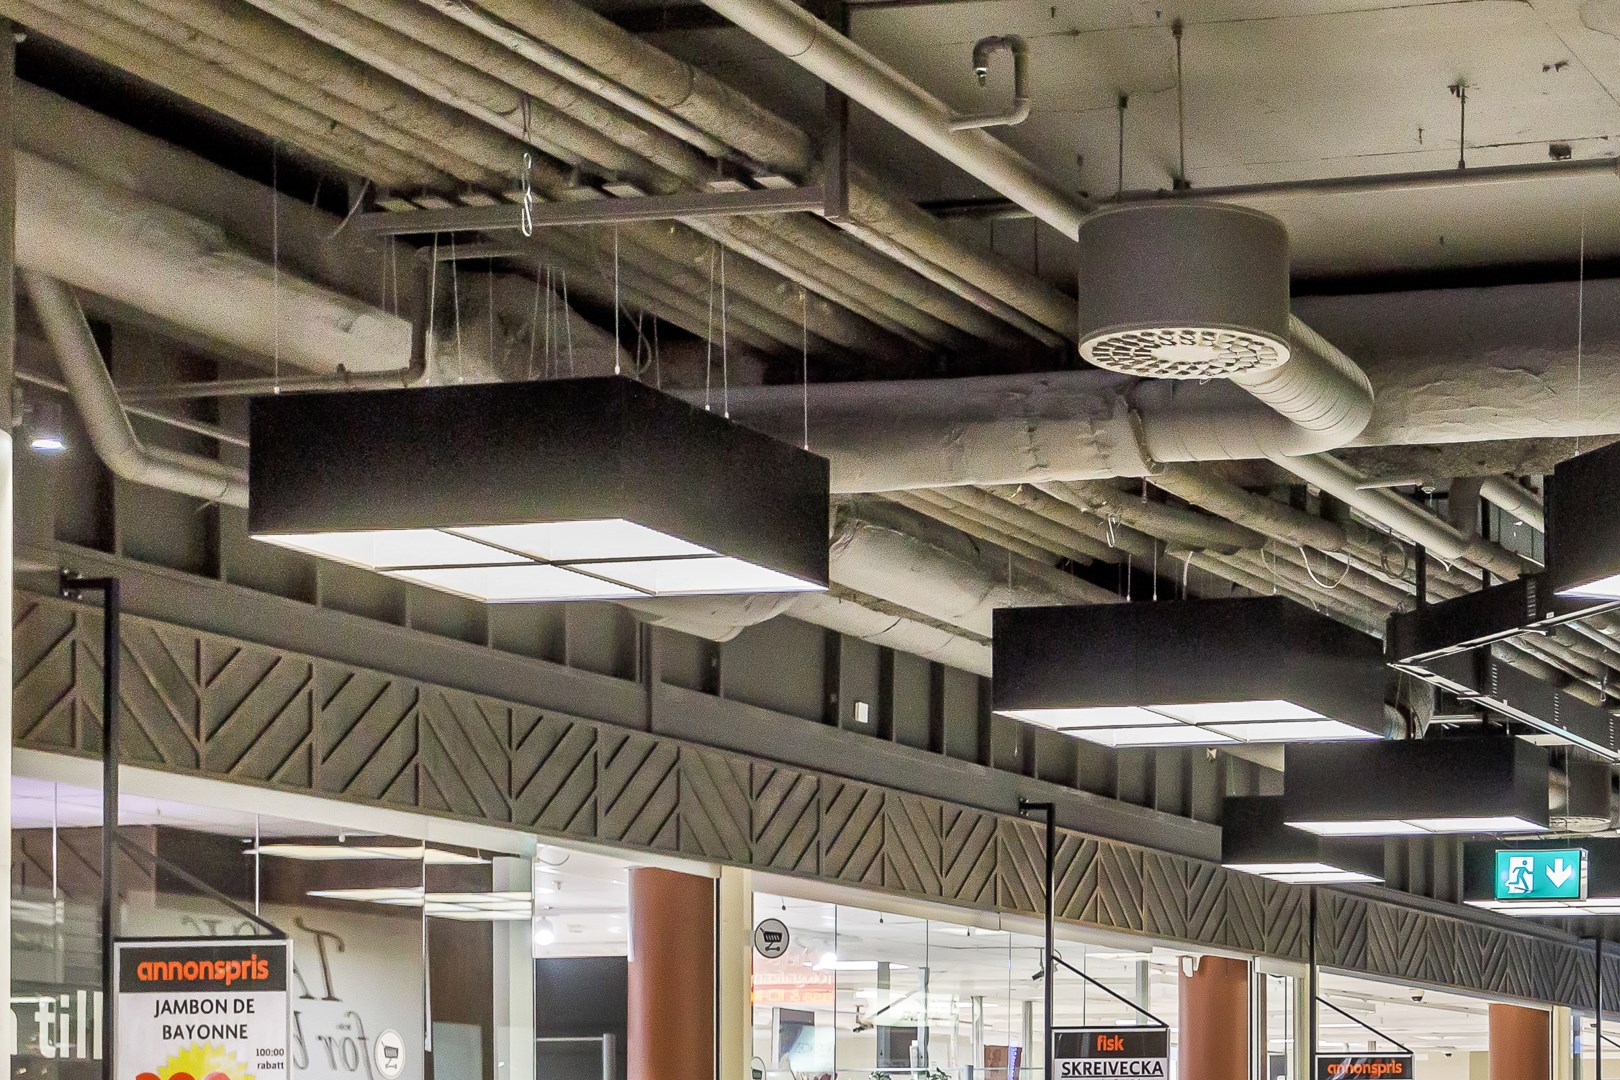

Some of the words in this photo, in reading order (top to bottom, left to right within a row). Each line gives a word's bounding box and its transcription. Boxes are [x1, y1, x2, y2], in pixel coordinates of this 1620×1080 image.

[137, 954, 269, 986] annonspris
[154, 999, 227, 1018] JAMBON
[233, 998, 256, 1014] DE
[34, 989, 103, 1060] till
[162, 1024, 248, 1040] BAYONNE
[1097, 1035, 1124, 1051] fisk
[256, 1048, 285, 1057] 100:00
[257, 1061, 285, 1070] rabatt
[1061, 1061, 1164, 1077] SKREIVECKA
[1327, 1060, 1403, 1076] annonspris
